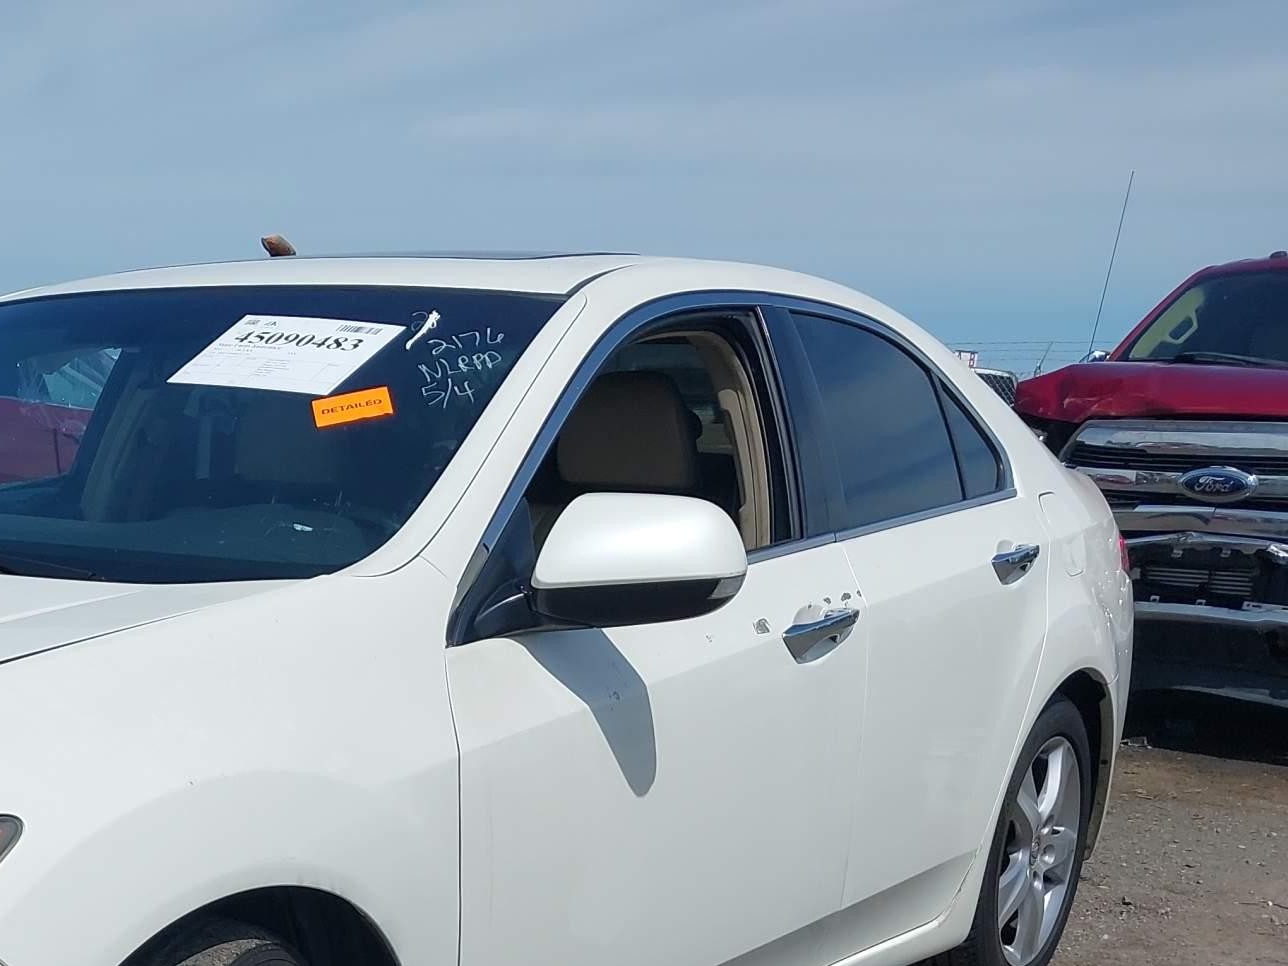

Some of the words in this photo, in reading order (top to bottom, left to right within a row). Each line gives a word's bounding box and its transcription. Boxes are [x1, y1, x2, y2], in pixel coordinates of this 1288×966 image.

[235, 330, 365, 352] 45090483
[427, 327, 505, 355] 2176
[421, 378, 475, 409] 5/4
[321, 399, 383, 416] DETAILED
[1194, 476, 1234, 492] Ford
